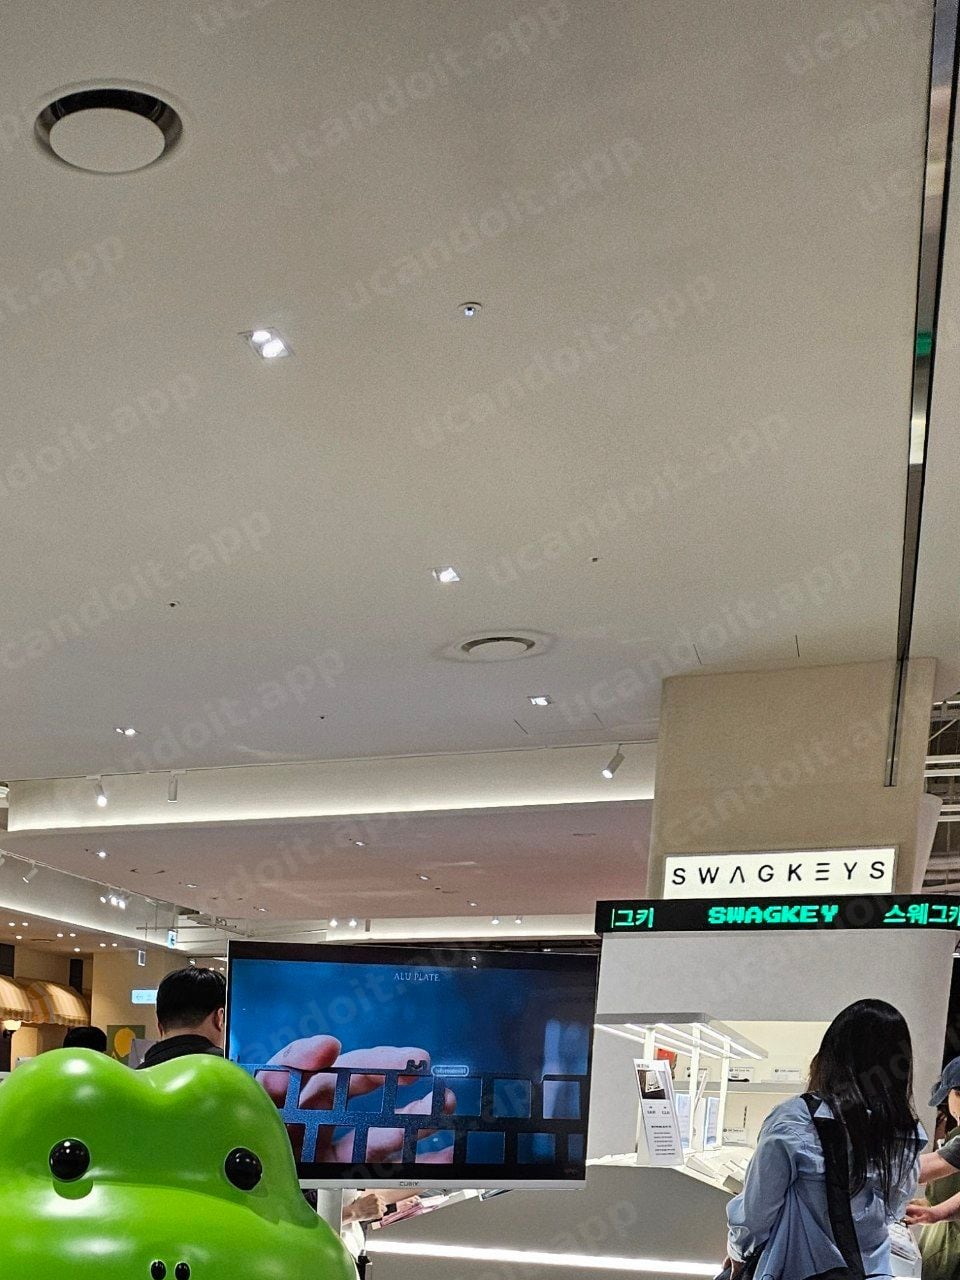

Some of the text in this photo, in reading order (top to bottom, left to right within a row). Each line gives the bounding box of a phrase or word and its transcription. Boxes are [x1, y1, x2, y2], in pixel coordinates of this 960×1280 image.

[671, 861, 885, 886] SWAGKEYS
[610, 907, 655, 928] 그키
[707, 904, 840, 924] SWAGKEY
[414, 972, 440, 982] PLATE
